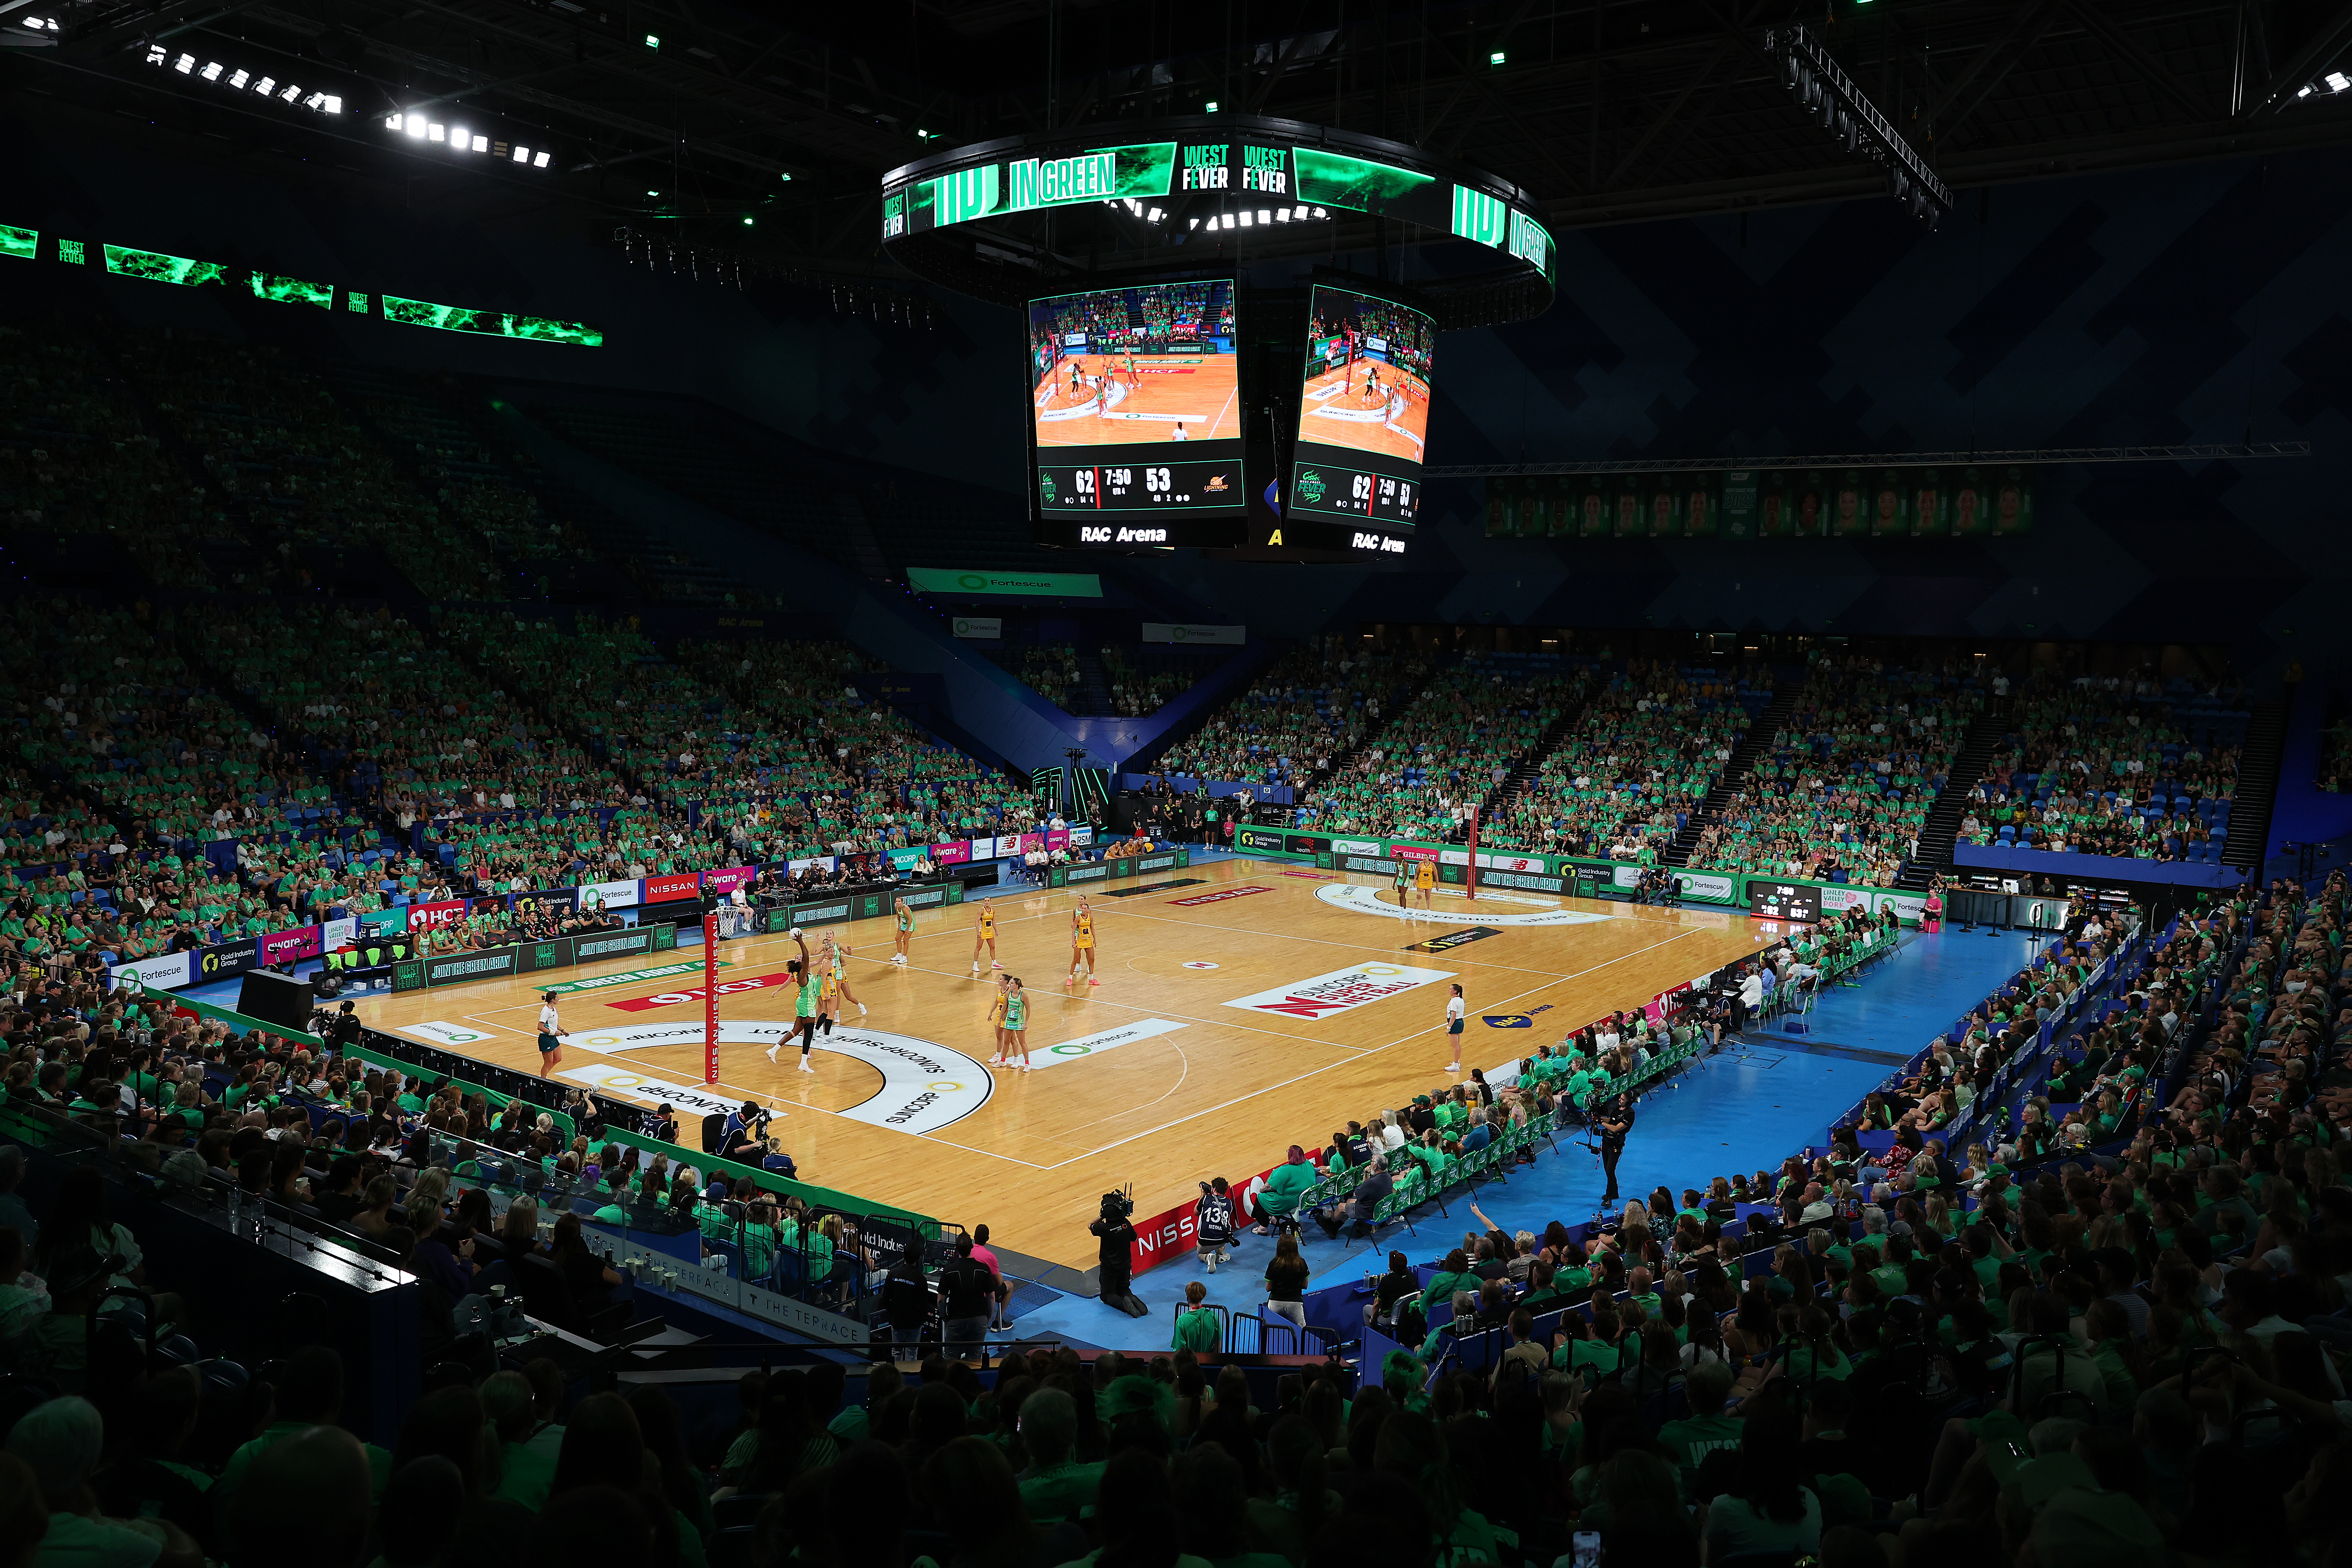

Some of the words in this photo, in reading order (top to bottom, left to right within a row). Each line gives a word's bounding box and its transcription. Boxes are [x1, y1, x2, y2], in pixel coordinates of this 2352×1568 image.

[1184, 145, 1229, 167] WEST
[1244, 145, 1286, 171] WEST
[1190, 162, 1221, 171] COAST
[1250, 163, 1279, 173] COAST
[1009, 158, 1040, 210] IN
[1039, 152, 1116, 202] GREEN
[1182, 167, 1228, 190] FEVER
[1242, 169, 1286, 194] FEVER
[885, 194, 903, 218] WEST
[884, 214, 903, 239] FEVER
[59, 239, 84, 253] WEST
[1523, 221, 1546, 271] GREEN
[59, 250, 84, 265] FEVER
[349, 291, 368, 303] WEST
[349, 301, 368, 314] FEVER
[1076, 470, 1094, 493] 62
[1105, 468, 1131, 485] 7:50
[1146, 468, 1171, 492] 53
[1297, 483, 1326, 494] FEVER
[1353, 475, 1371, 500] 62
[1379, 478, 1395, 496] 7:50
[1400, 483, 1410, 506] 53
[1723, 493, 1756, 509] 2022
[1082, 527, 1112, 542] RAC
[1116, 527, 1166, 542] Arena
[1352, 532, 1379, 549] RAC
[1380, 536, 1405, 553] Arena
[990, 579, 1051, 588] Fortescue
[1077, 835, 1091, 844] RSM
[1345, 857, 1361, 869] JOIN
[1363, 859, 1375, 871] THE
[1443, 865, 1458, 874] WEST
[650, 882, 694, 894] NISSAN
[1482, 872, 1500, 884] JOIN
[1501, 873, 1515, 886] THE
[1515, 875, 1539, 889] GREEN
[1539, 877, 1563, 892] ARMY
[601, 889, 632, 899] Fortescue
[915, 893, 929, 904] GREEN
[929, 891, 943, 902] ARMY
[1178, 887, 1264, 905] NISSAN
[1579, 889, 1595, 897] FEVER
[552, 896, 572, 906] Industry
[865, 896, 879, 906] WEST
[771, 909, 786, 920] WEST
[793, 911, 807, 923] JOIN
[807, 910, 817, 921] THE
[817, 908, 833, 920] GREEN
[833, 905, 848, 917] ARMY
[864, 905, 879, 916] FEVER
[771, 920, 786, 931] FEVER
[1519, 915, 1568, 923] SUNCORP
[328, 925, 344, 934] LINLEY
[328, 930, 344, 940] VALLEY
[656, 926, 674, 938] WEST
[267, 937, 300, 952] aware
[329, 937, 345, 946] PORK
[579, 943, 596, 956] JOIN
[595, 942, 608, 954] THE
[608, 939, 628, 952] GREEN
[628, 935, 647, 948] ARMY
[656, 937, 674, 949] FEVER
[221, 952, 234, 961] Gold
[234, 948, 255, 959] Industry
[535, 944, 556, 956] WEST
[221, 959, 238, 967] Group
[431, 965, 451, 979] JOIN
[451, 963, 465, 976] THE
[465, 960, 489, 974] GREEN
[488, 955, 511, 970] ARMY
[536, 955, 556, 968] FEVER
[141, 966, 181, 982] Fortescue
[397, 964, 420, 976] WEST
[574, 974, 642, 988] GREEN
[634, 966, 695, 978] ARMY
[397, 977, 420, 989] FEVER
[1292, 974, 1369, 997] SUNCORP
[1315, 983, 1381, 1000] SUPER
[1337, 982, 1421, 1004] NETBALL
[1493, 1017, 1522, 1027] RAC
[1523, 1004, 1555, 1016] Arena
[1081, 1031, 1137, 1046] Fortescue
[880, 1046, 945, 1073] SUNCORP
[637, 1086, 738, 1114] SUNCORP
[885, 1092, 940, 1124] SUNCORP
[766, 1299, 789, 1317] THE
[796, 1310, 858, 1341] TERRACE
